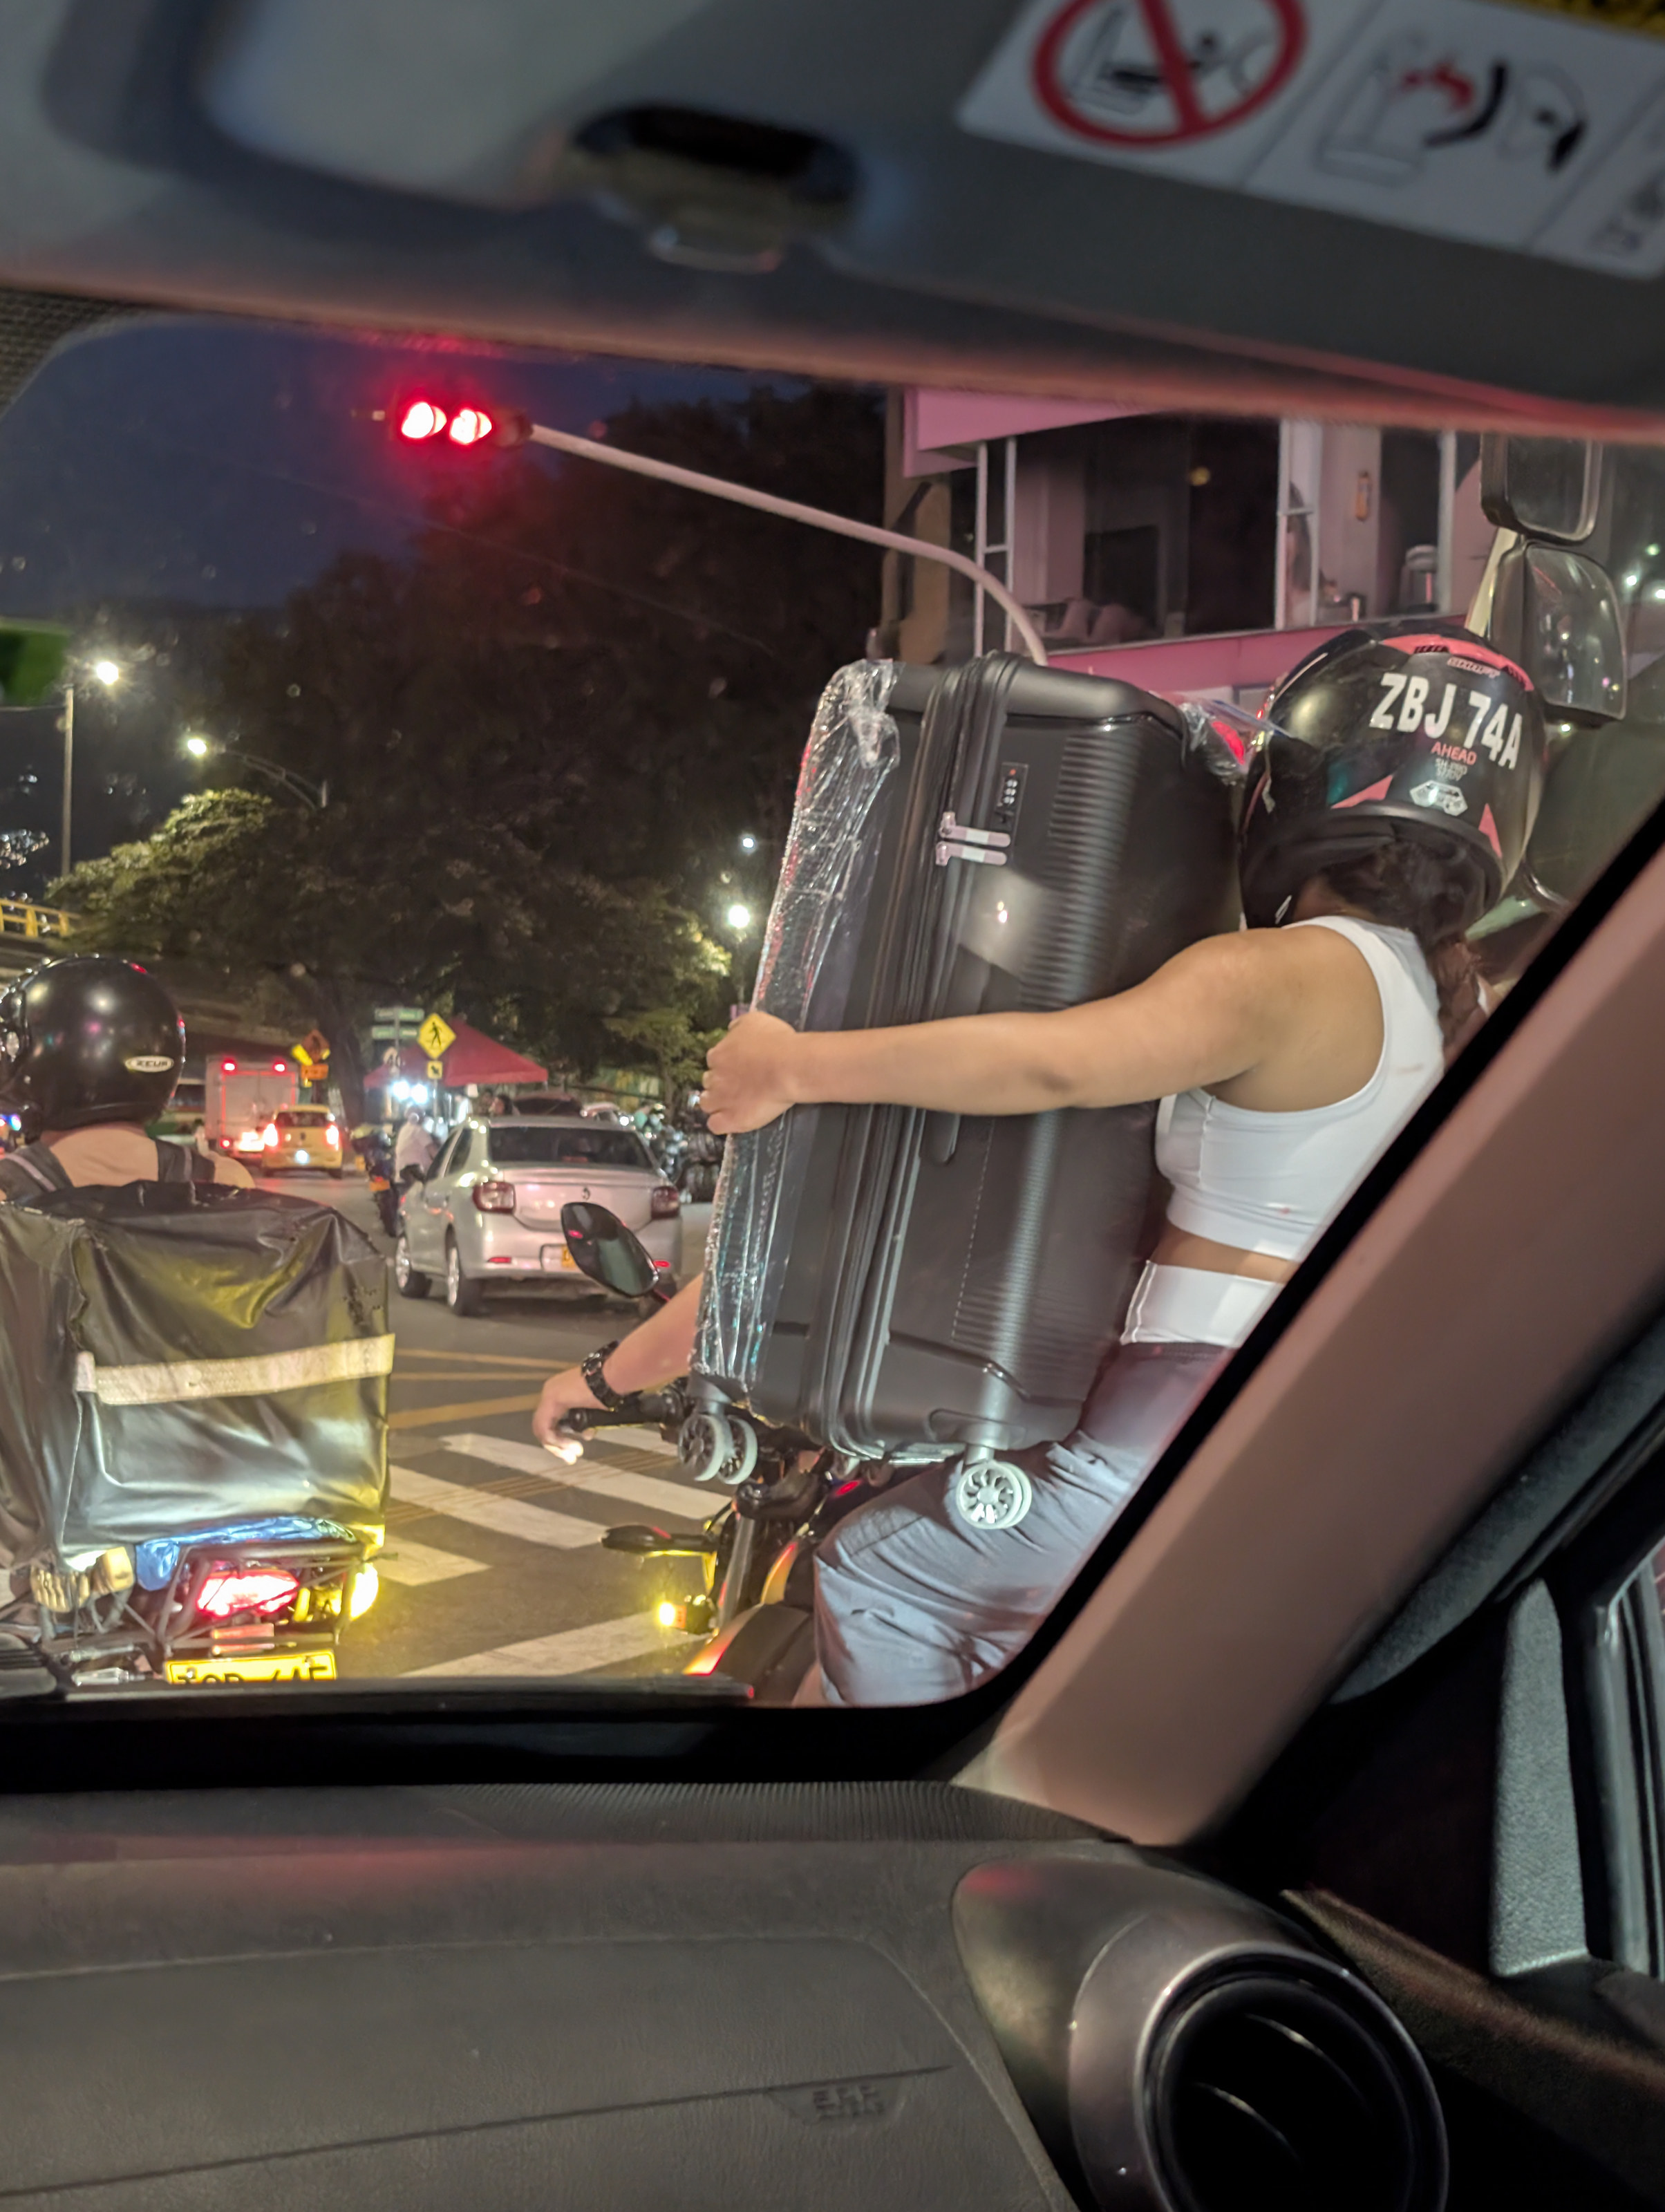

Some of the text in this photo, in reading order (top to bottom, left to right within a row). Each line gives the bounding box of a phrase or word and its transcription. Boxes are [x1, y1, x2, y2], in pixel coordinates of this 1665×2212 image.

[1369, 673, 1523, 769] ZBJ 74A
[1431, 742, 1477, 765] AHEAD
